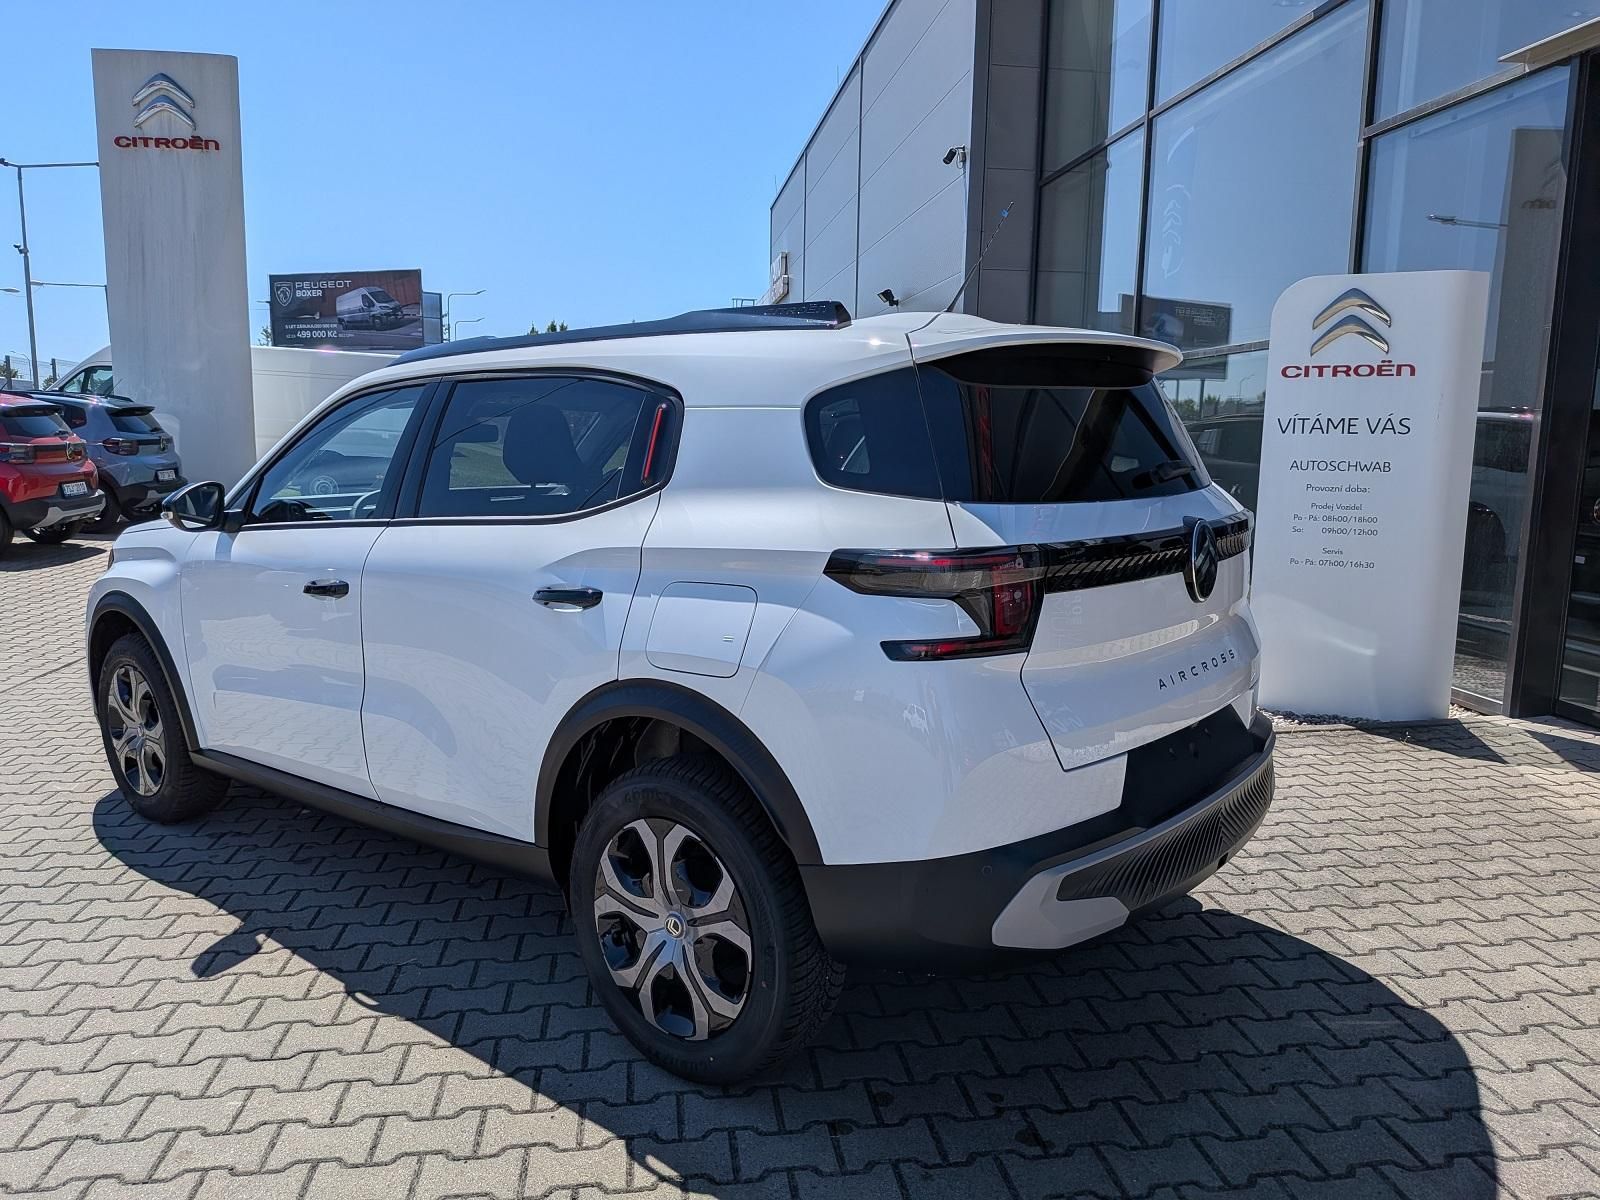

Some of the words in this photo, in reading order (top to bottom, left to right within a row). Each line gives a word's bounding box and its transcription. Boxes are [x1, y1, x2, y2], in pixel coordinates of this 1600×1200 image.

[295, 280, 352, 289] PEUGEOT
[297, 330, 311, 338] 499
[312, 330, 326, 338] 000
[1281, 360, 1416, 379] CITROËN
[1277, 413, 1359, 435] VÍTÁME
[1366, 412, 1411, 435] VÁS
[1289, 460, 1392, 473] AUTOSCHWAB
[1345, 484, 1371, 493] doba:
[1311, 502, 1334, 511] Prodej
[1336, 503, 1363, 511] Vozidel
[1321, 515, 1378, 524] 08h00/18h00
[1321, 527, 1378, 536] 09h00/12h00
[1322, 547, 1344, 555] Servis
[1318, 559, 1375, 569] 07h00/16h30
[1158, 649, 1236, 690] AIRCROSS
